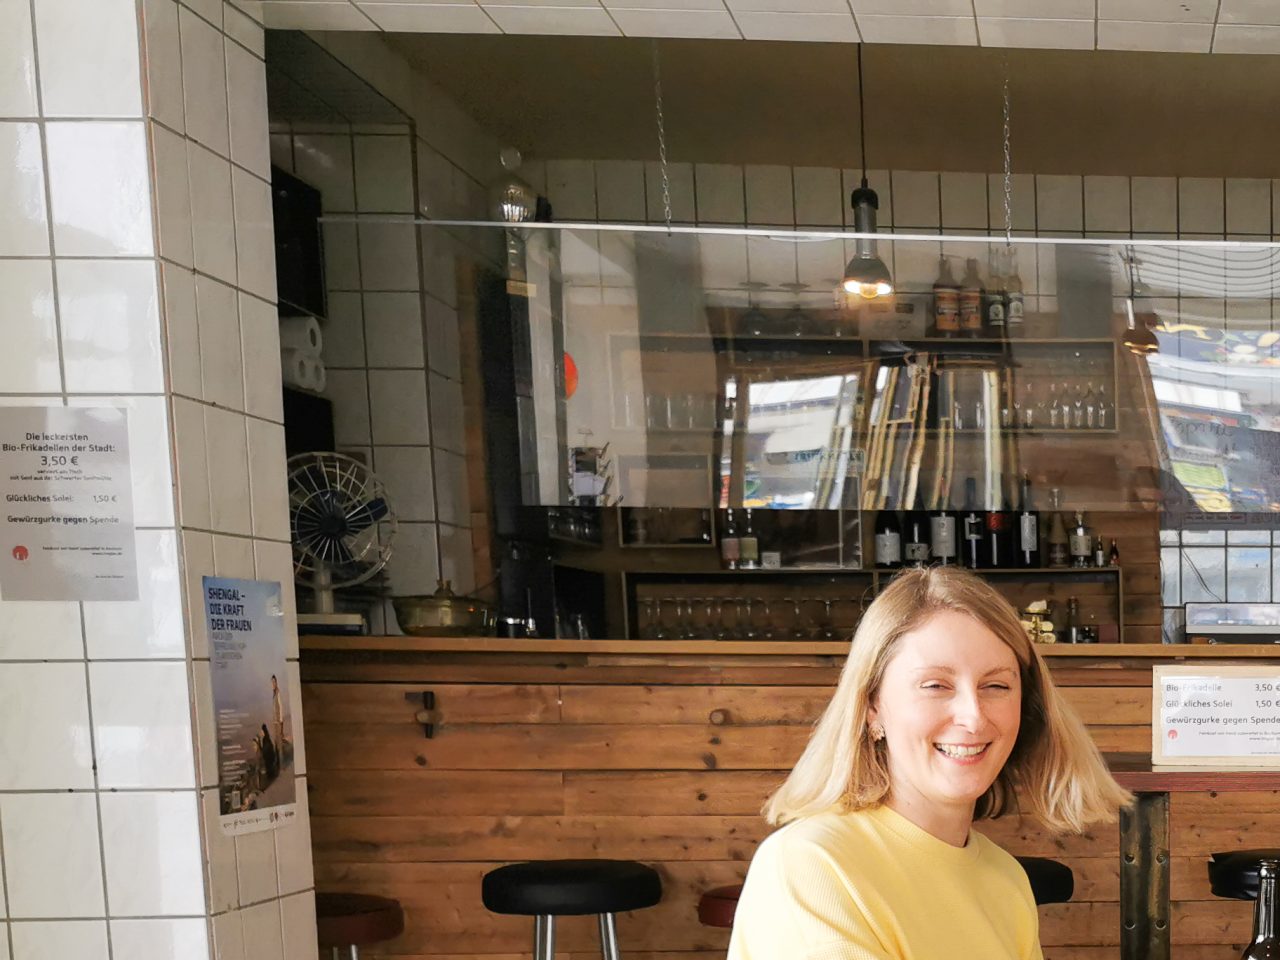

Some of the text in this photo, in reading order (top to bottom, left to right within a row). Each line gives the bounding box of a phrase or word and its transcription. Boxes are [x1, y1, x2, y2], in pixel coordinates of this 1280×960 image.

[42, 433, 88, 441] leckersten
[2, 444, 70, 452] Bio-Frikadellen
[88, 444, 115, 452] Stadt:
[40, 456, 79, 466] 3,50 €
[6, 494, 50, 502] Glückliches
[92, 494, 110, 504] 1,50
[8, 516, 62, 524] Gewürzgurke
[89, 516, 120, 524] Spende
[208, 588, 240, 601] SHENGAL
[210, 603, 244, 617] DIE KRAFT
[211, 618, 252, 632] DER FRAUEN
[1255, 684, 1273, 692] 3,50
[1166, 700, 1211, 708] Glükliches
[1213, 700, 1232, 708] Solei
[1256, 700, 1272, 708] 1,50
[1166, 716, 1280, 725] Gewürzgurke gegen Spende
